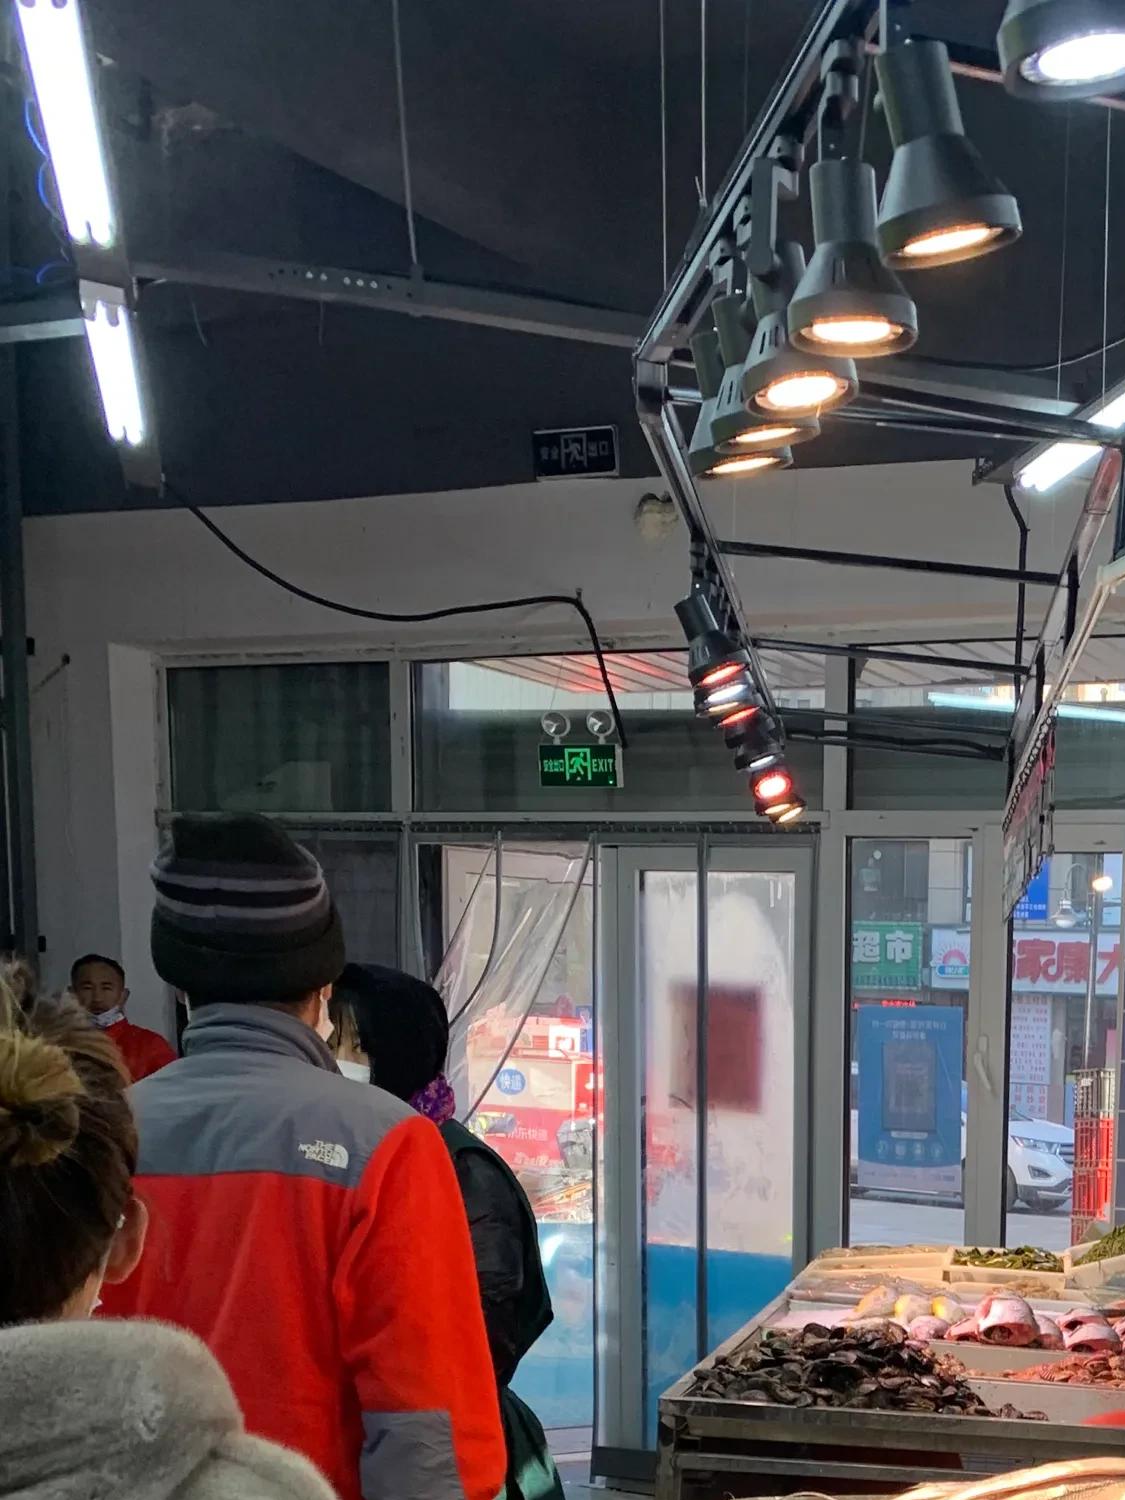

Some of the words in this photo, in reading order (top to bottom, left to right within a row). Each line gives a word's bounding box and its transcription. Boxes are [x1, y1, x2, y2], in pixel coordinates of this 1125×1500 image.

[591, 758, 614, 773] EXIT
[851, 929, 914, 964] 超市
[1012, 938, 1120, 985] 家康大
